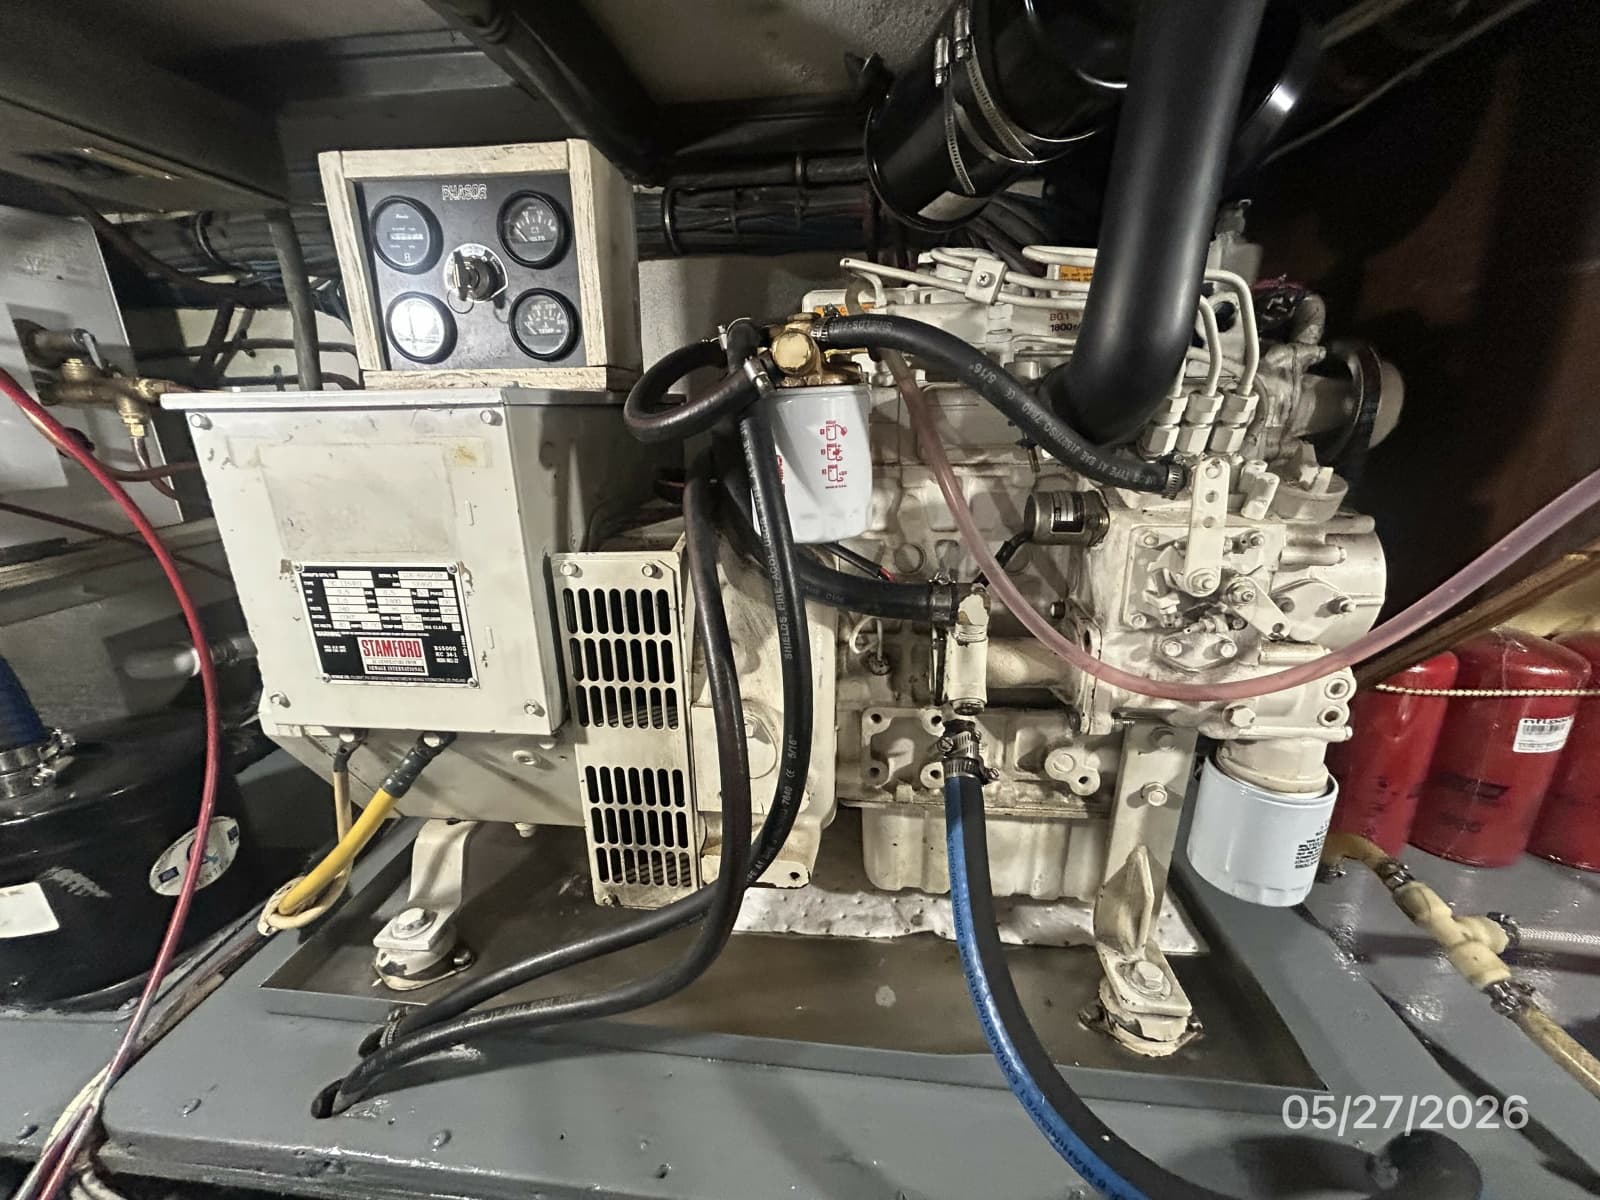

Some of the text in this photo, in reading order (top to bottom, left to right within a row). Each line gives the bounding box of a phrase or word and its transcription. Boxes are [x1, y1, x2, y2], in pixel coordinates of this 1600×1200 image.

[441, 184, 487, 200] PHASOR
[779, 615, 793, 660] SHIELDS
[361, 639, 423, 658] STAMFORD
